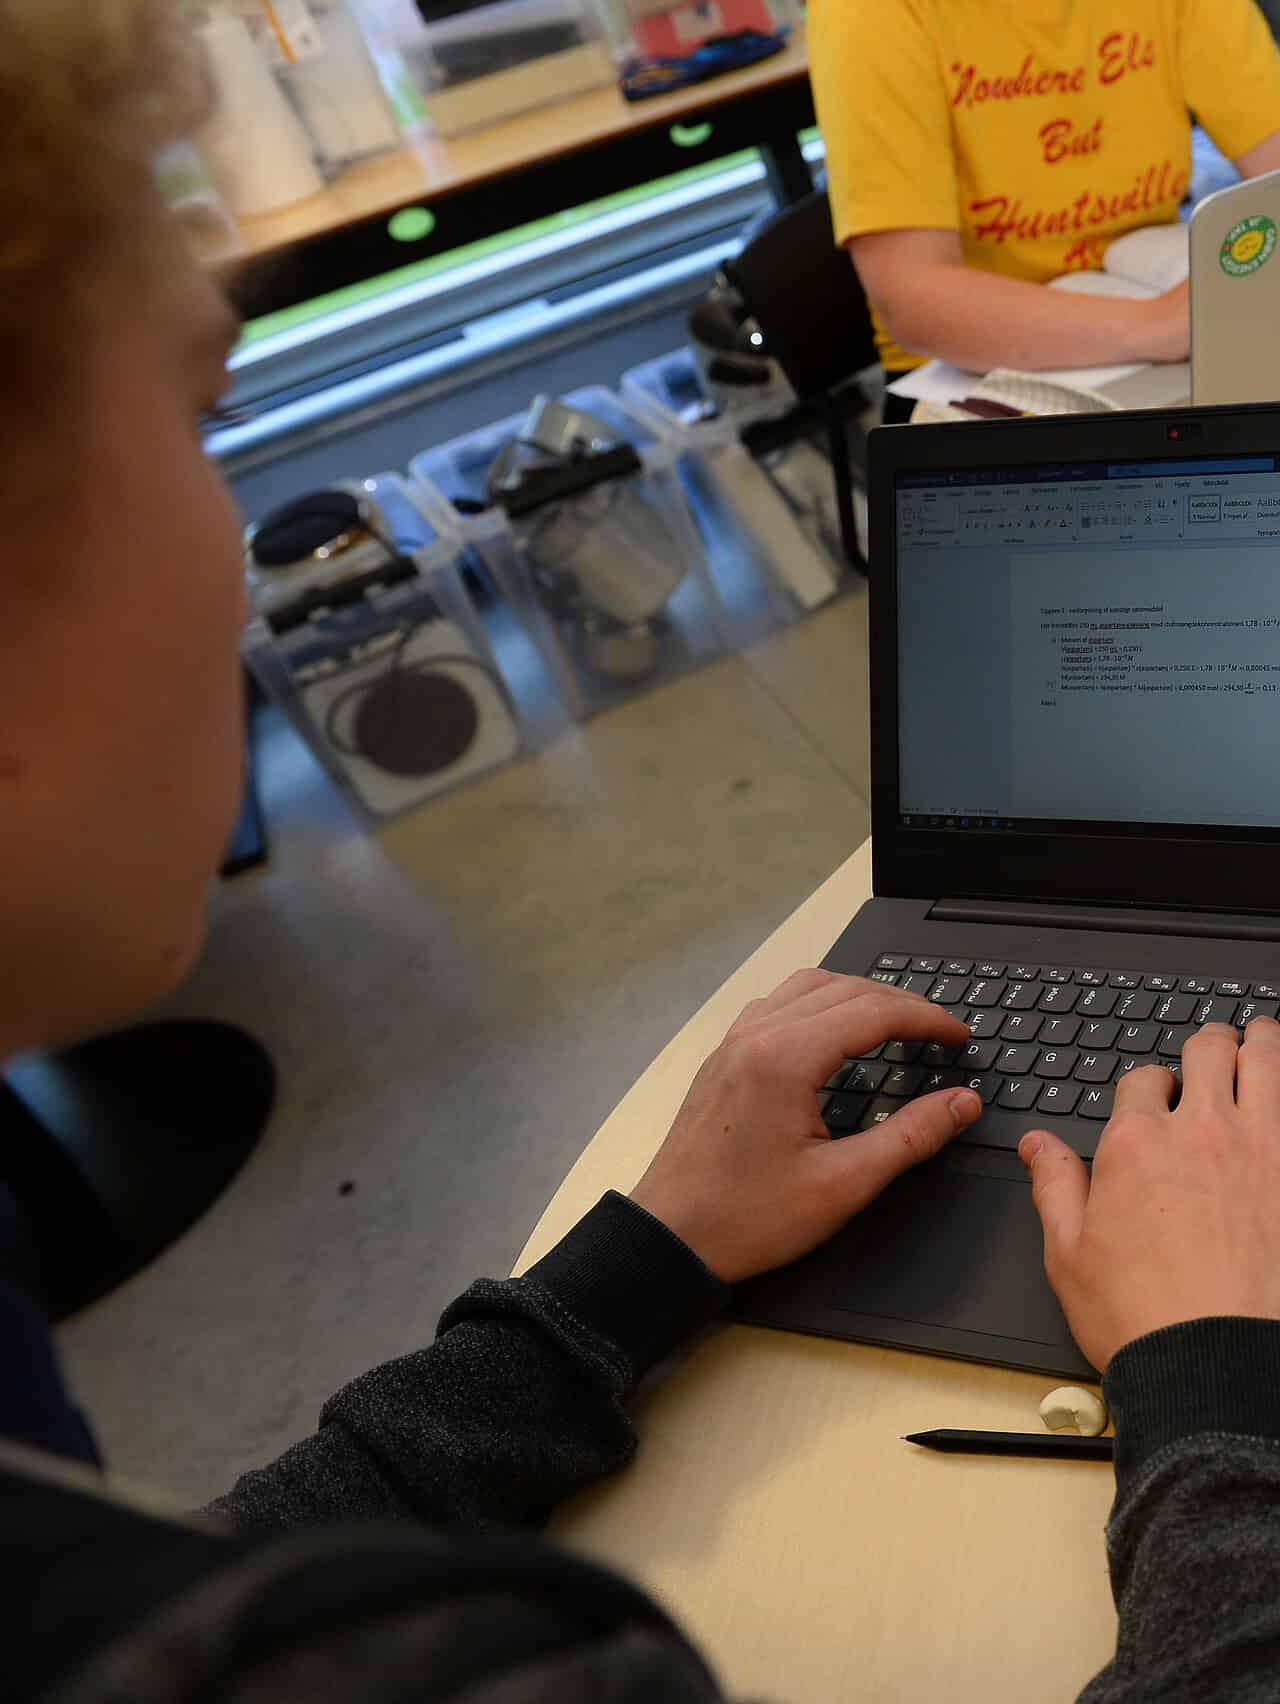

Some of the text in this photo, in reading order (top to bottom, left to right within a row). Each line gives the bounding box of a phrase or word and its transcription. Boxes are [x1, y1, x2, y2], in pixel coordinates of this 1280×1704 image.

[950, 31, 1156, 109] Nowhere Els
[1038, 116, 1103, 166] But
[973, 1013, 985, 1023] E
[1010, 1016, 1022, 1026] R
[1050, 1020, 1061, 1030] T
[1089, 1023, 1100, 1033] Y
[1126, 1027, 1139, 1037] U
[967, 1045, 979, 1055] D
[1005, 1048, 1017, 1058] F
[1045, 1052, 1057, 1062] G
[1084, 1056, 1097, 1066] H
[1124, 1060, 1135, 1071] J
[893, 1071, 1101, 1102] Z X C V B N
